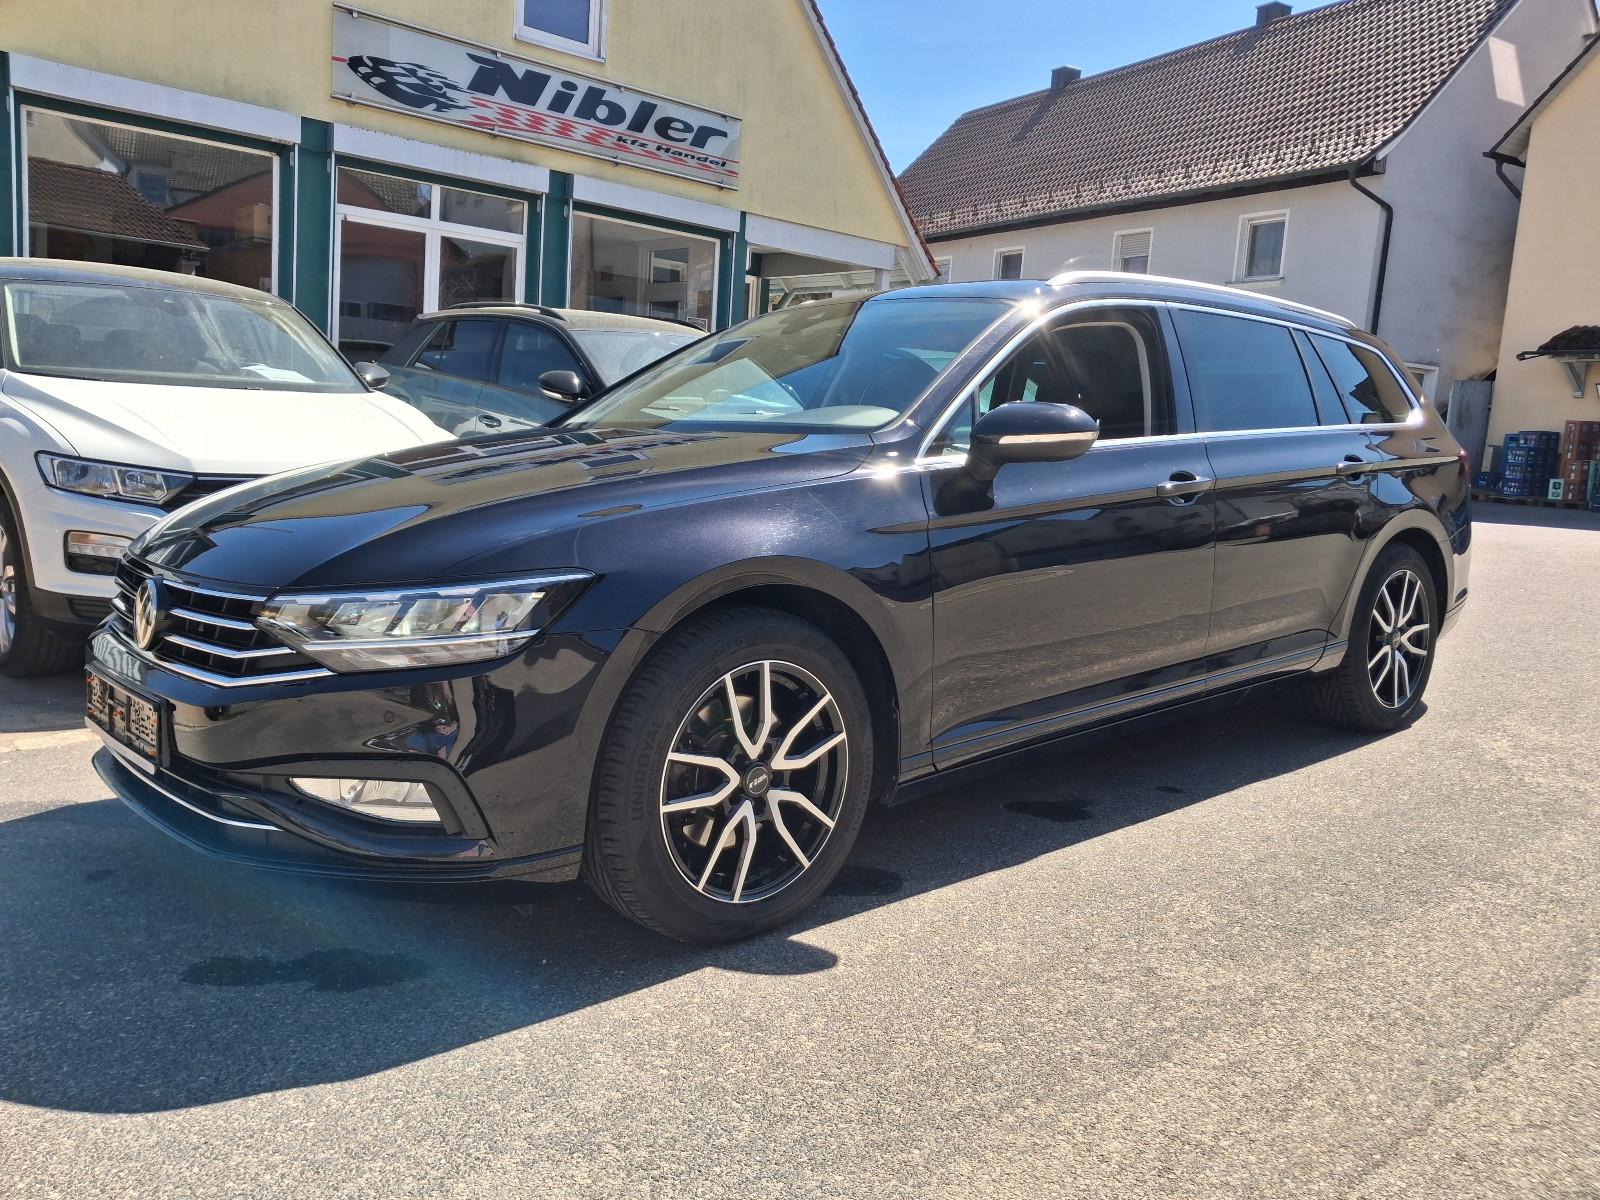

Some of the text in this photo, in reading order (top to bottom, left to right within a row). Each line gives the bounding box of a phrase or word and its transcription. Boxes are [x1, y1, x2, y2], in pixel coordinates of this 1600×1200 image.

[466, 52, 728, 149] Nibler
[655, 144, 727, 168] Handel
[631, 719, 664, 822] UNIROYAL
